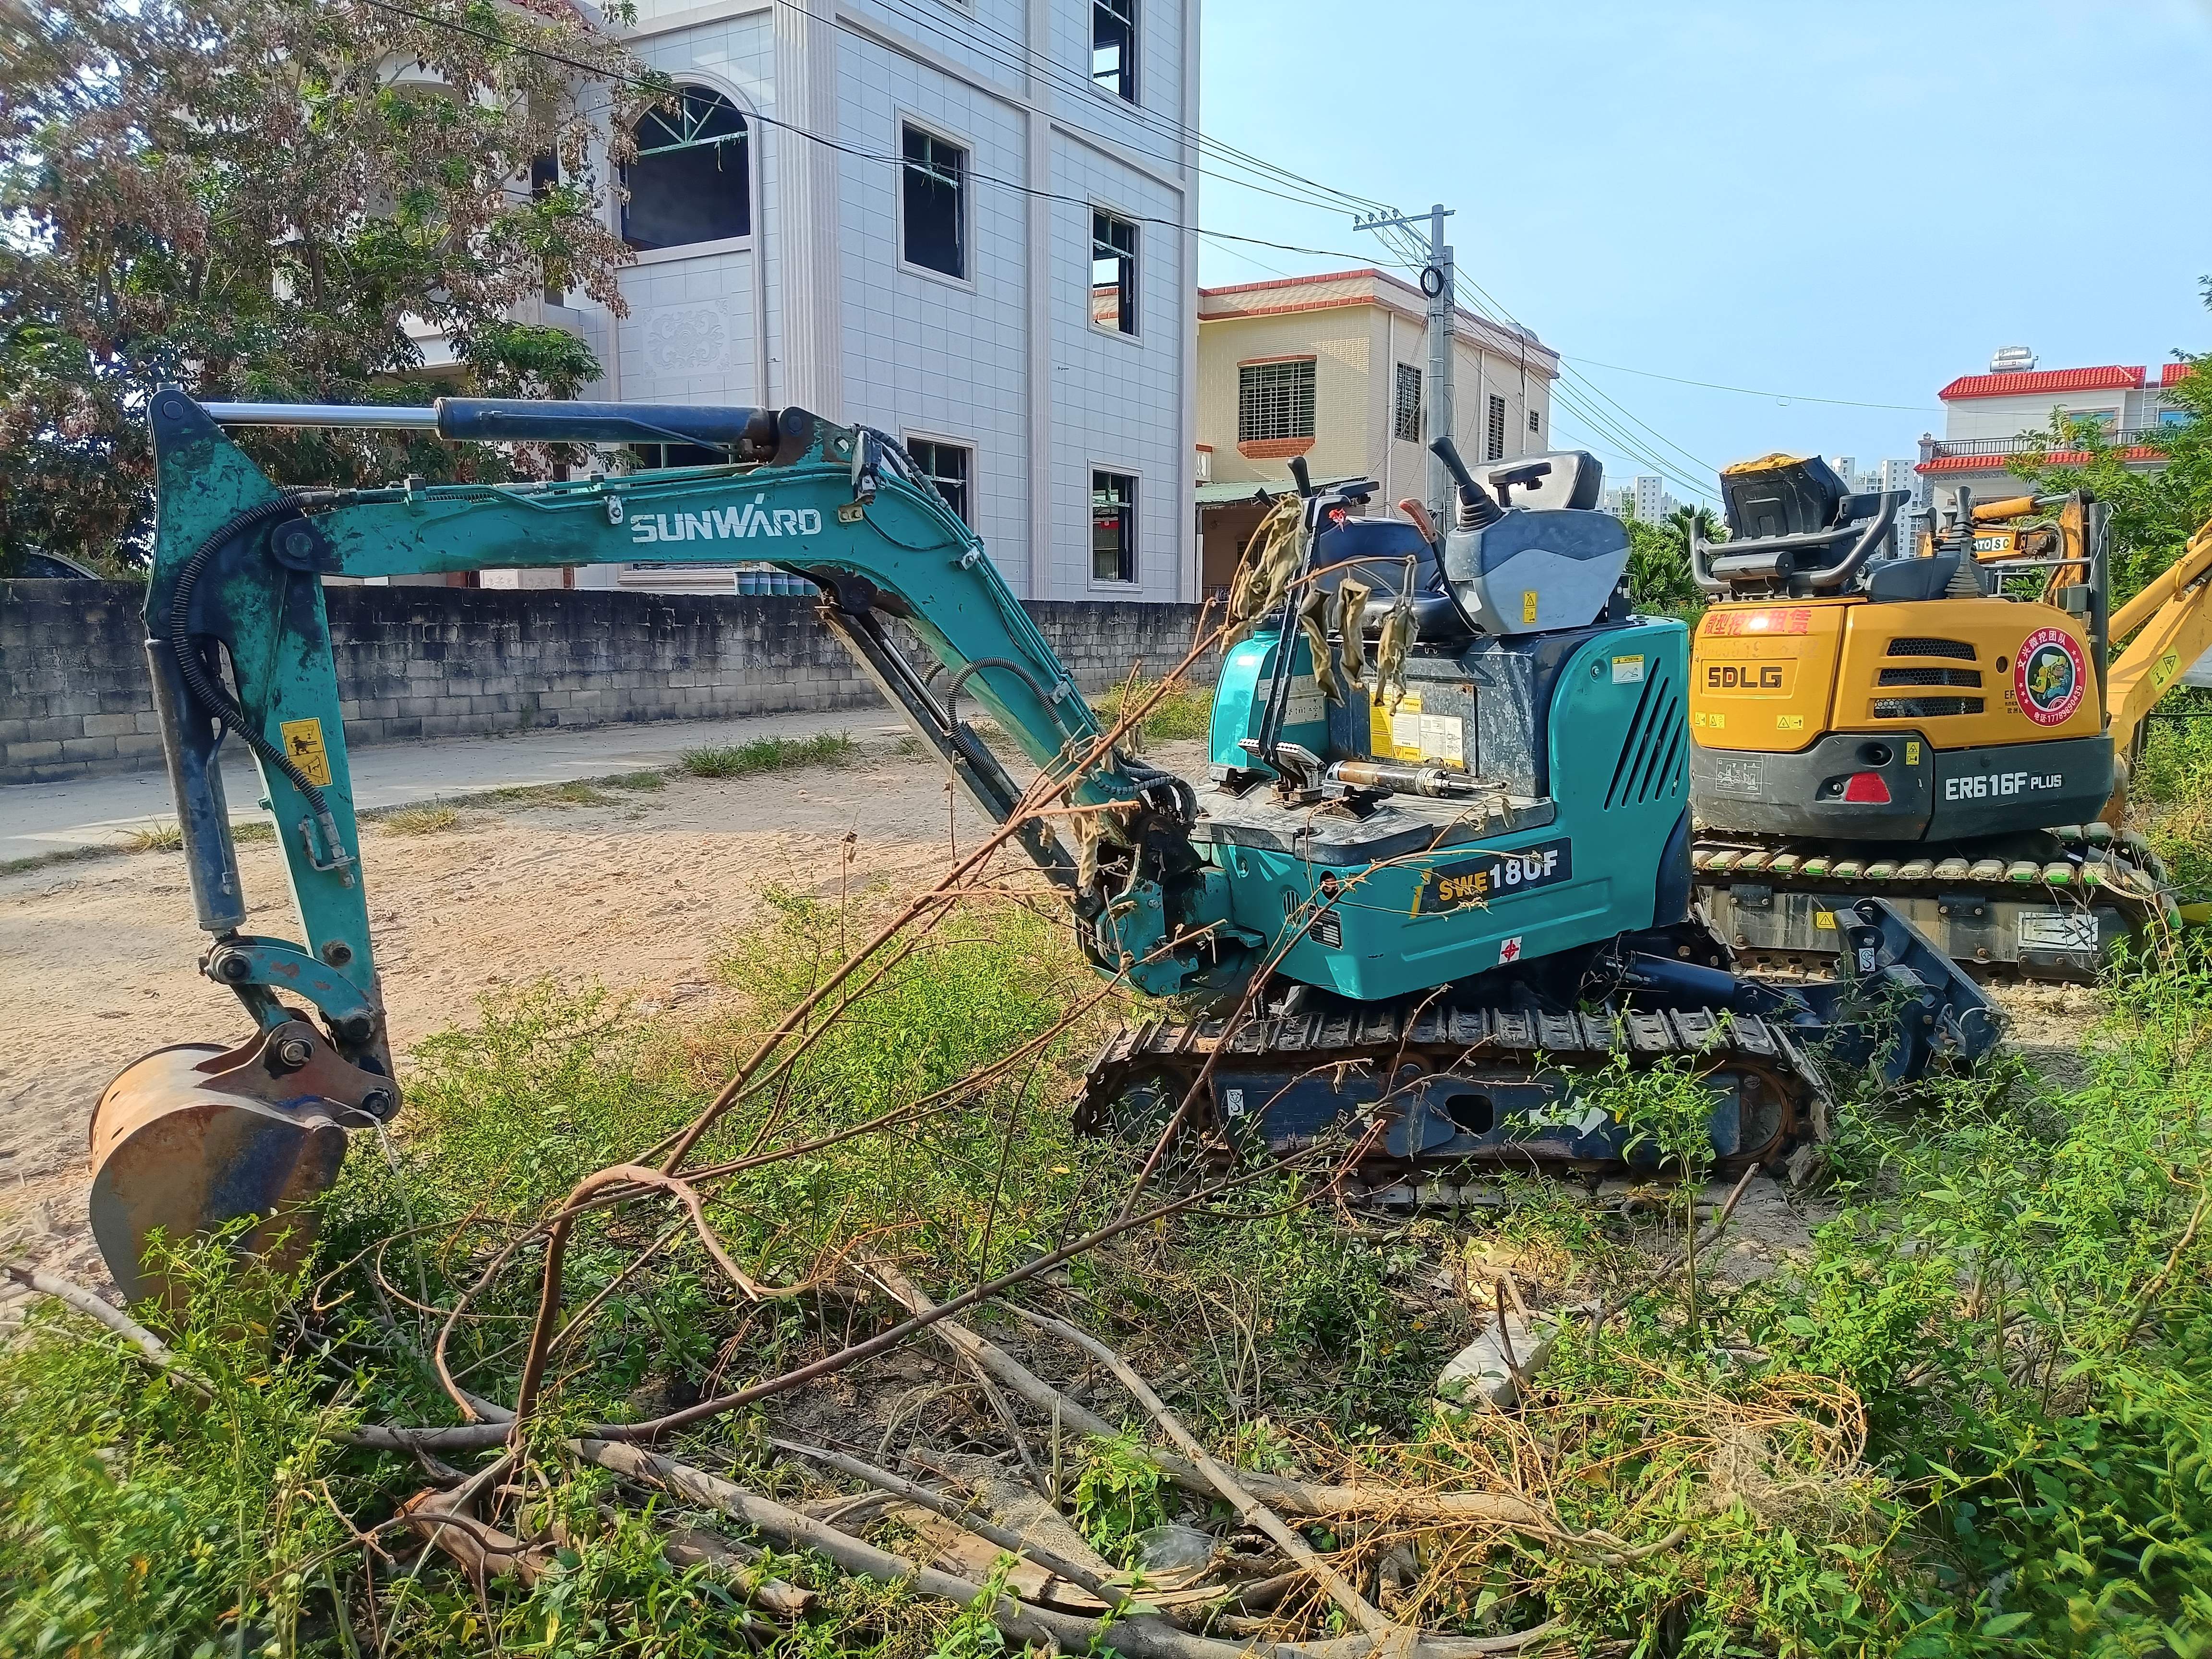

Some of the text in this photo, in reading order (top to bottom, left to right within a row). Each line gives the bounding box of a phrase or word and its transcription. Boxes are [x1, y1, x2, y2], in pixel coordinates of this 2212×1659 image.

[630, 493, 821, 543] SUNWARD
[1708, 667, 1782, 688] SDLG
[1946, 771, 2062, 801] ER616F PLUS
